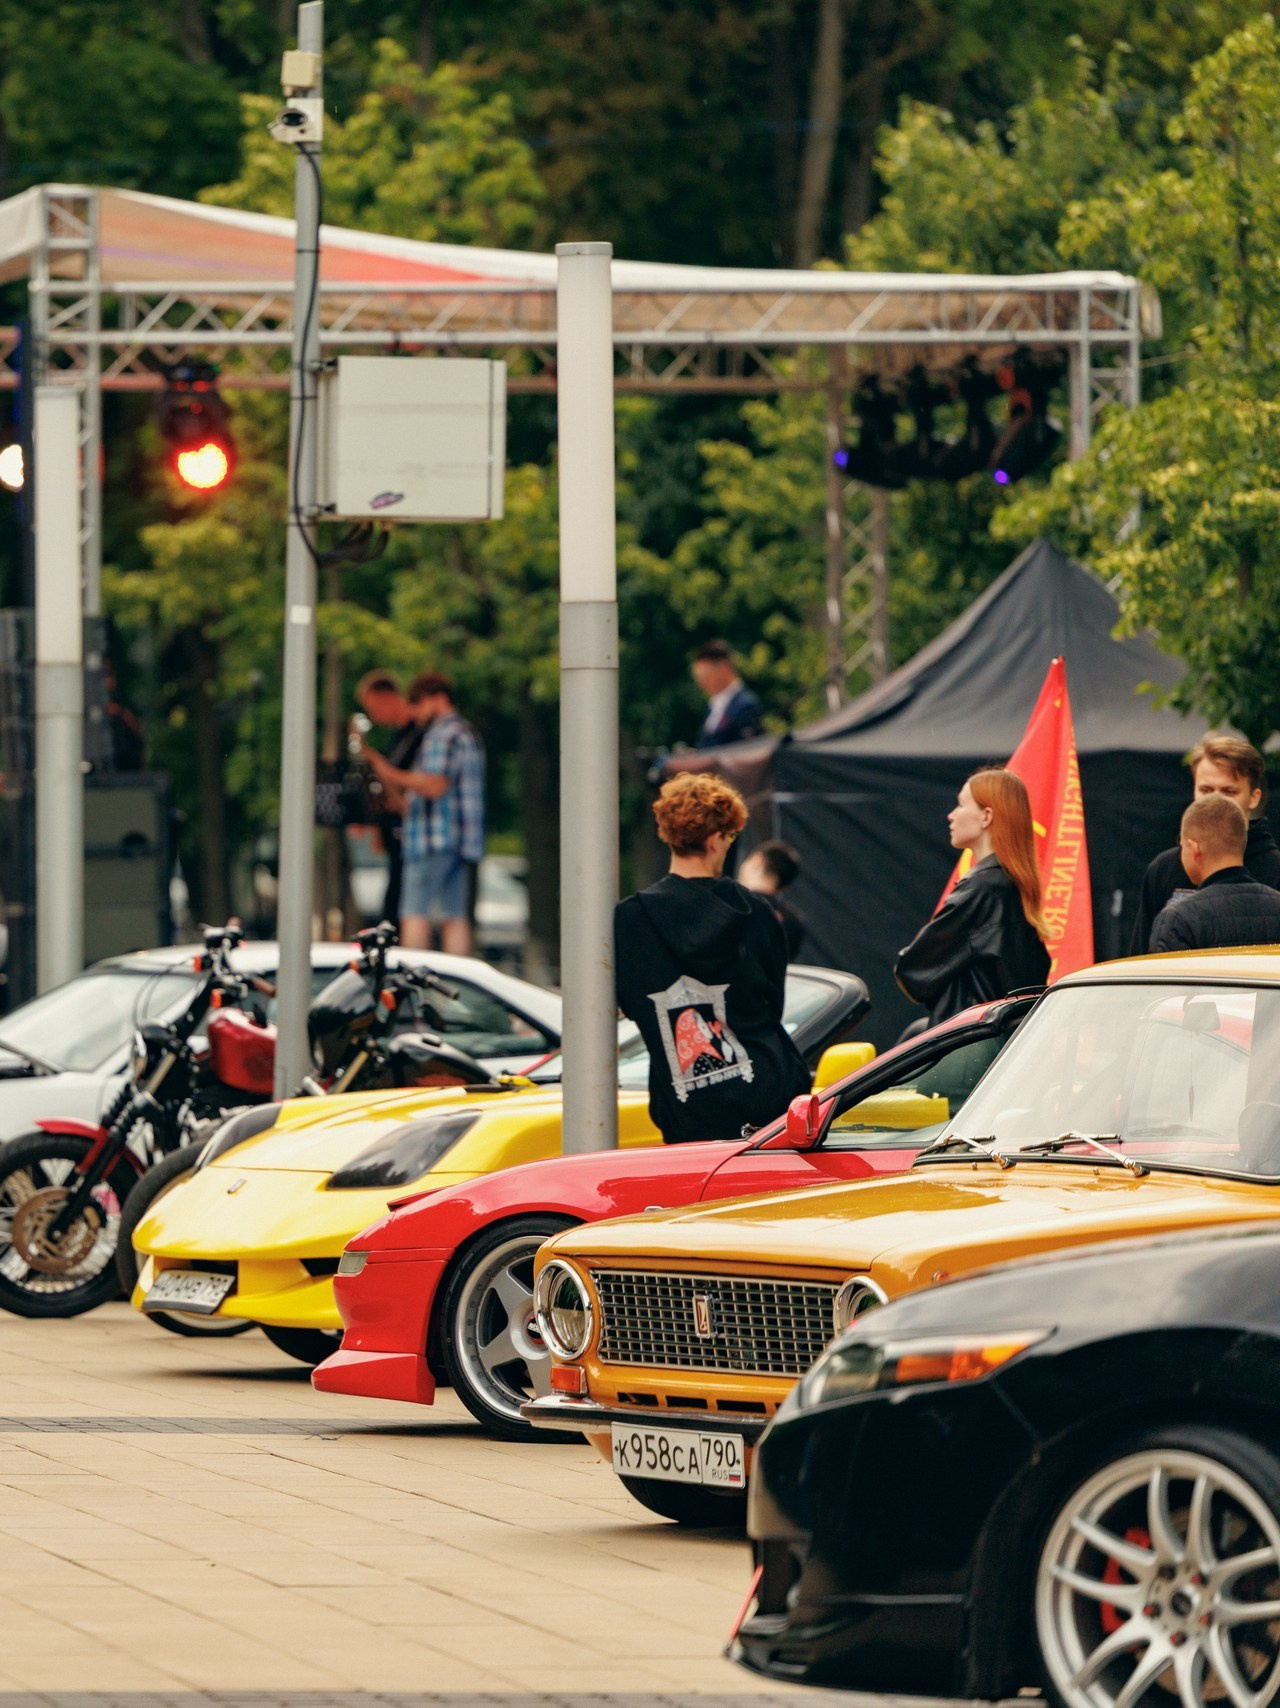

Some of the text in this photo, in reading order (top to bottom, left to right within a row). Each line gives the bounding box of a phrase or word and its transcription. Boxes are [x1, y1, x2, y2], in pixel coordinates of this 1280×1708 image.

[618, 1433, 737, 1475] К958СА 790
[711, 1468, 728, 1480] RUS
